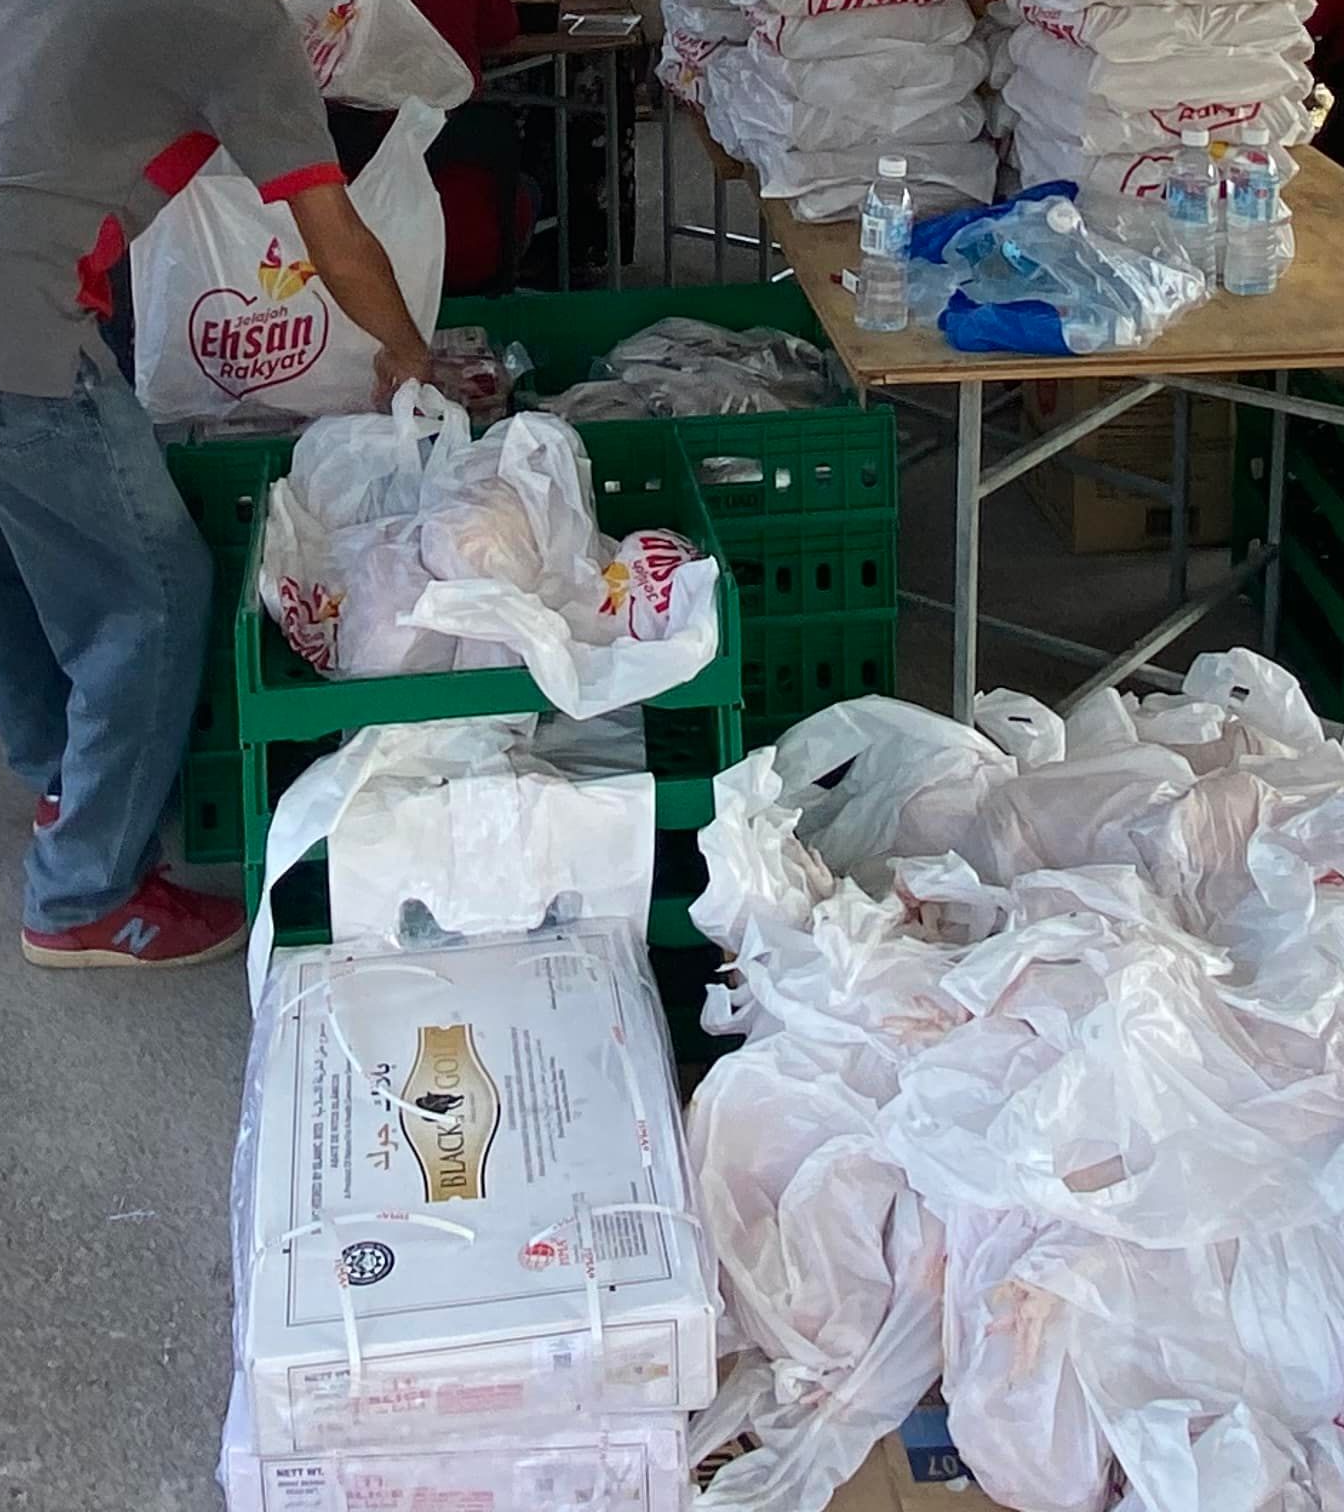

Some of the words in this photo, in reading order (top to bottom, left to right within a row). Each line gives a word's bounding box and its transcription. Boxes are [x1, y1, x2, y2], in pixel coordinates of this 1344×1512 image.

[234, 306, 288, 328] Jelajah
[200, 314, 314, 361] Ehsan
[220, 350, 308, 380] Rakyat
[437, 1124, 467, 1189] BLACK
[276, 1468, 303, 1478] NETT
[306, 1467, 325, 1477] WT.
